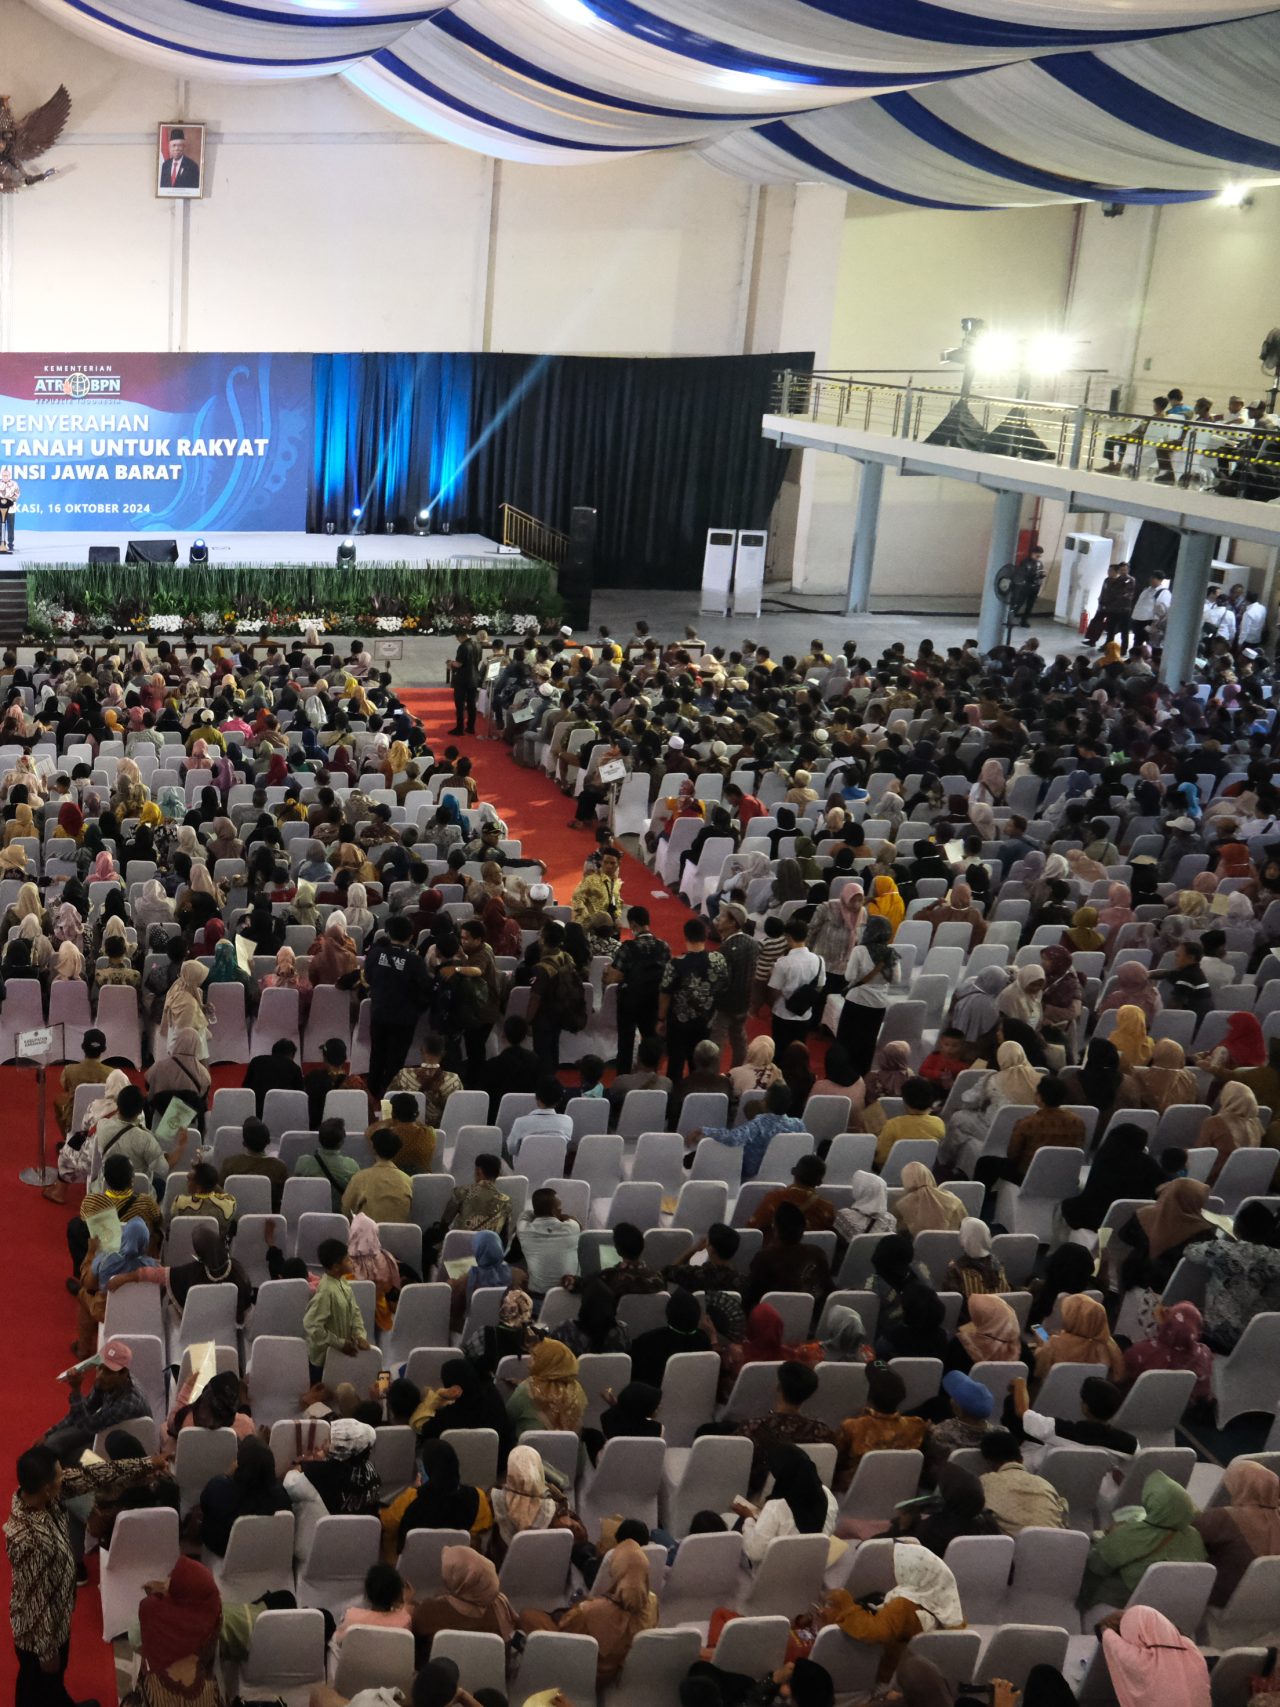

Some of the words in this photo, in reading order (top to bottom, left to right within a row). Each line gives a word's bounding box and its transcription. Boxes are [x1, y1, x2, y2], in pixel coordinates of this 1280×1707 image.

[35, 379, 64, 391] ATR
[90, 379, 120, 391] BPN
[2, 414, 149, 432] PENYERAHAN
[1, 438, 83, 456] TANAH
[91, 438, 170, 456] UNTUK
[177, 438, 269, 456] RAKYAT
[51, 464, 109, 480] JAWA
[115, 464, 182, 480] BARAT
[48, 504, 61, 513] 16
[65, 504, 119, 513] OKTOBER
[122, 504, 151, 513] 2024
